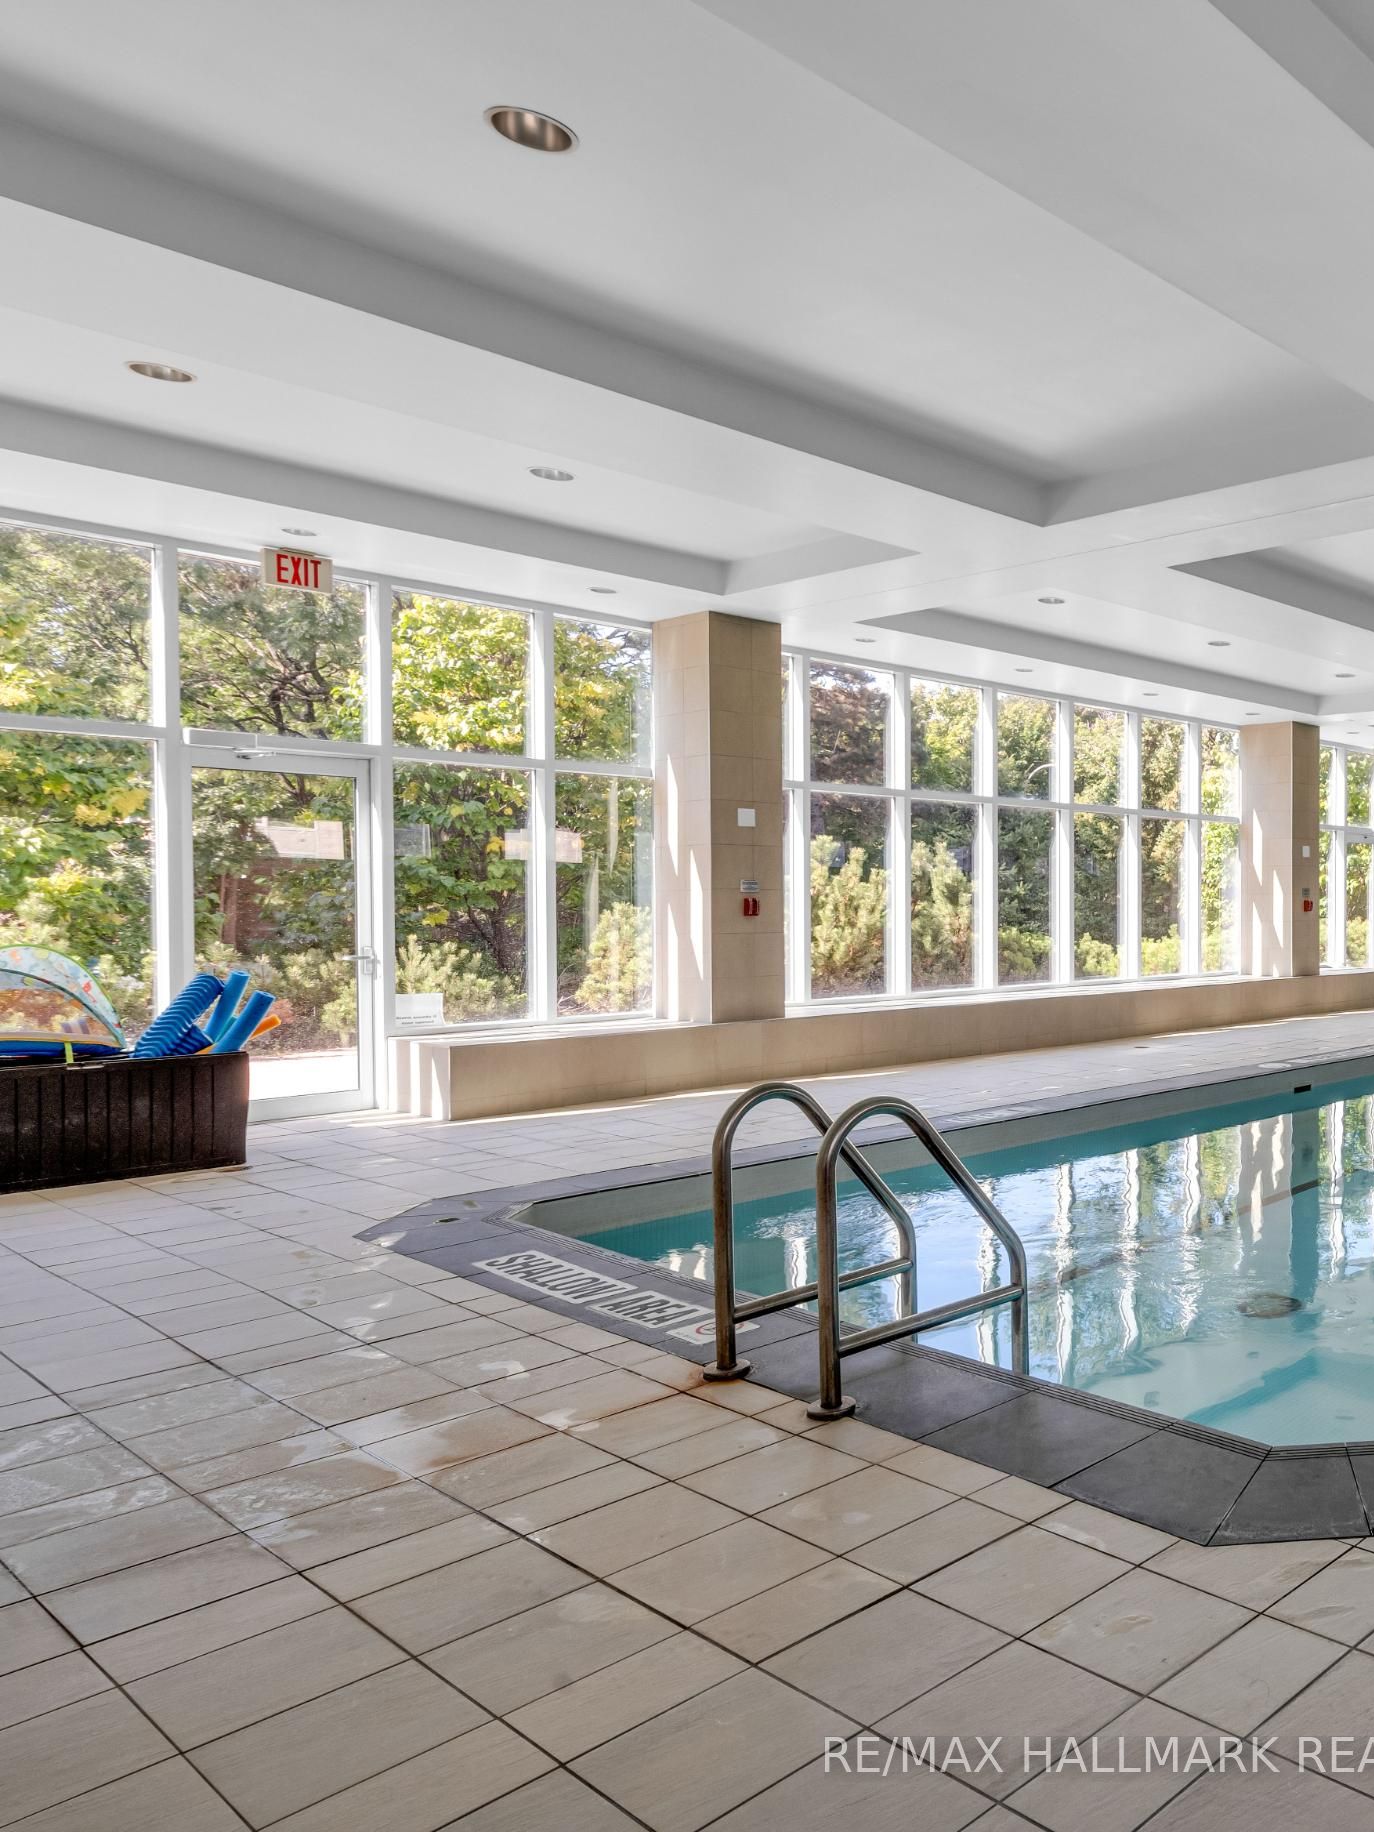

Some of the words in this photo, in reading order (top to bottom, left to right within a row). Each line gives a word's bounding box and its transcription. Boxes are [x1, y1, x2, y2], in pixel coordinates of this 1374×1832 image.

[276, 553, 322, 588] EXIT
[484, 1253, 627, 1300] SHALLOW
[600, 1294, 699, 1325] AREA
